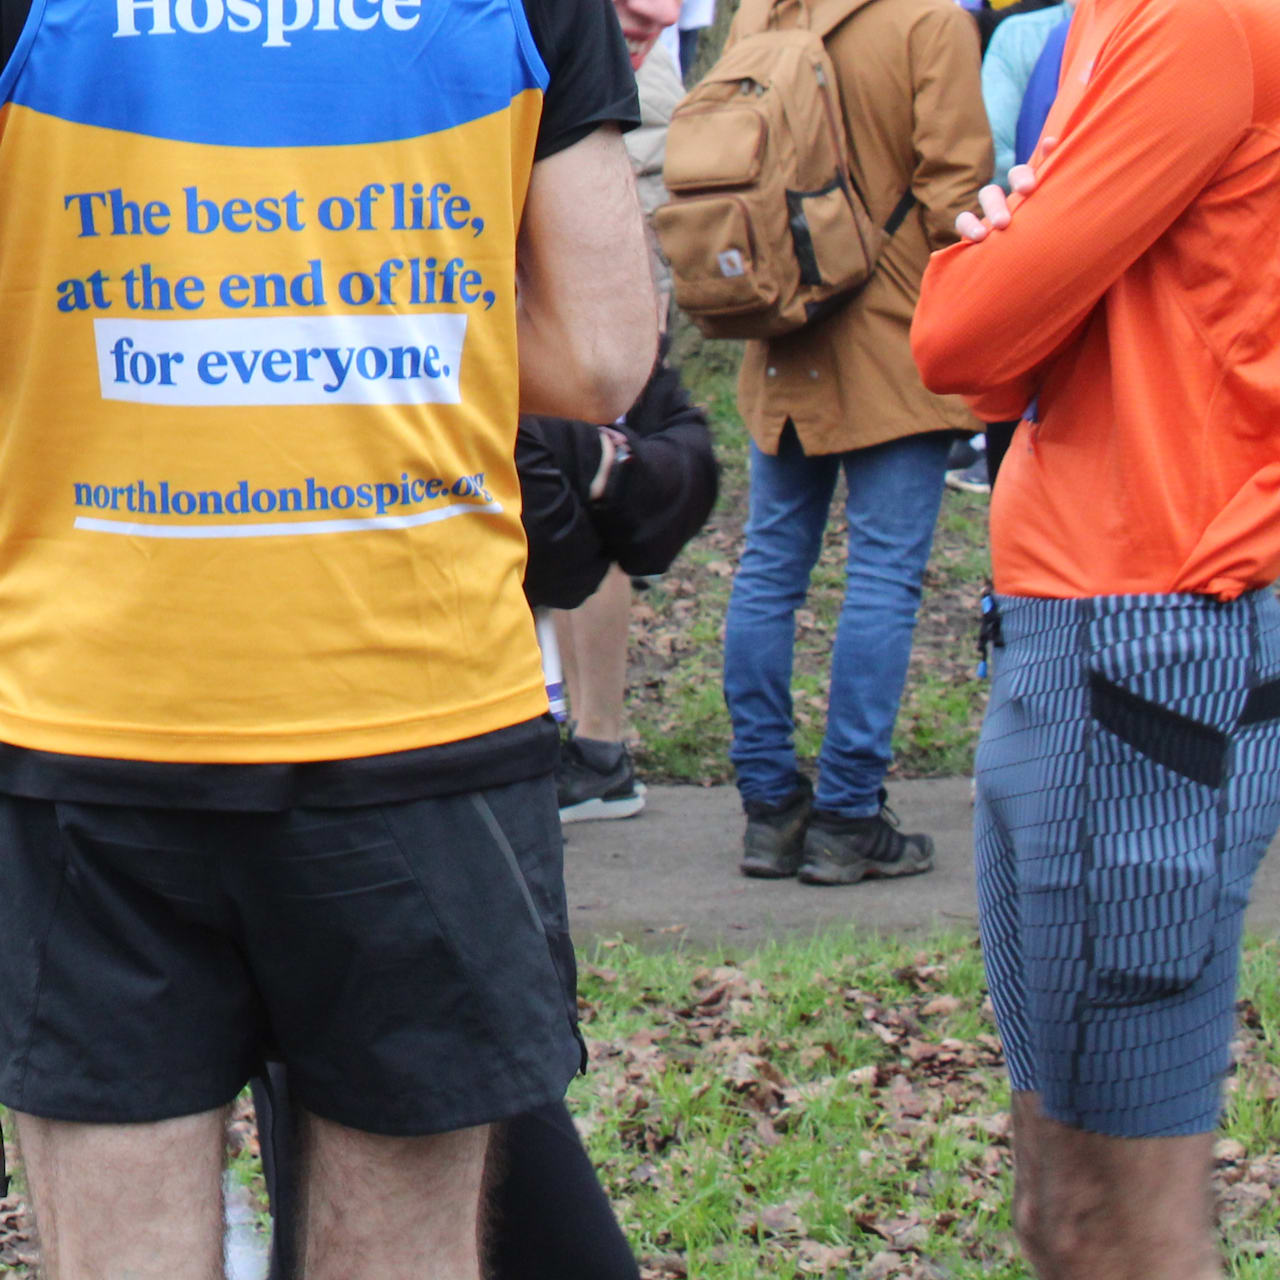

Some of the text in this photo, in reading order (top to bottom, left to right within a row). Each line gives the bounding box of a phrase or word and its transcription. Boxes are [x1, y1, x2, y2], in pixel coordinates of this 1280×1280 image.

[64, 182, 486, 239] The best of life,
[56, 256, 497, 313] at the end of life,
[110, 337, 452, 394] for everyone.
